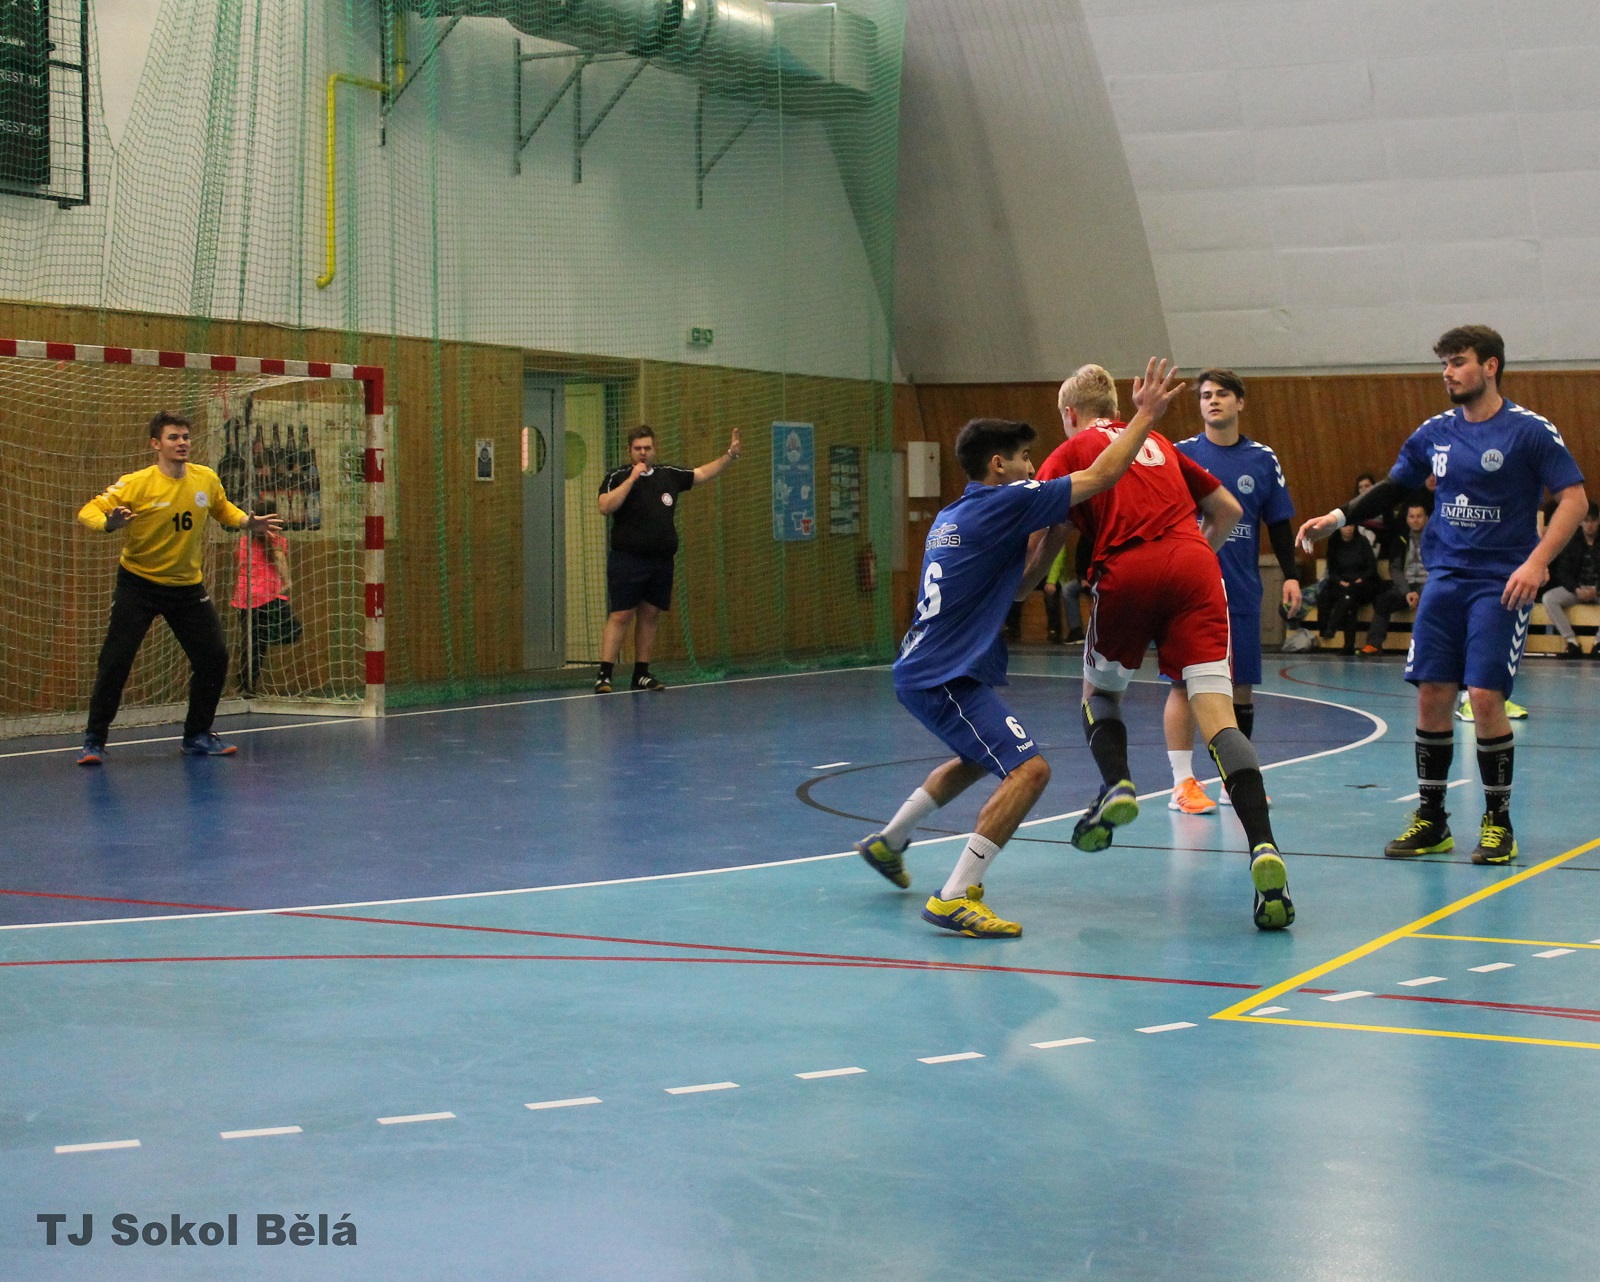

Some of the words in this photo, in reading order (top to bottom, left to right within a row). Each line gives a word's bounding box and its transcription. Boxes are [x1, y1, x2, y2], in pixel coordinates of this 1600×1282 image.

[1432, 452, 1448, 478] 18
[172, 510, 193, 532] 16
[917, 561, 943, 622] 6
[1005, 715, 1027, 739] 6
